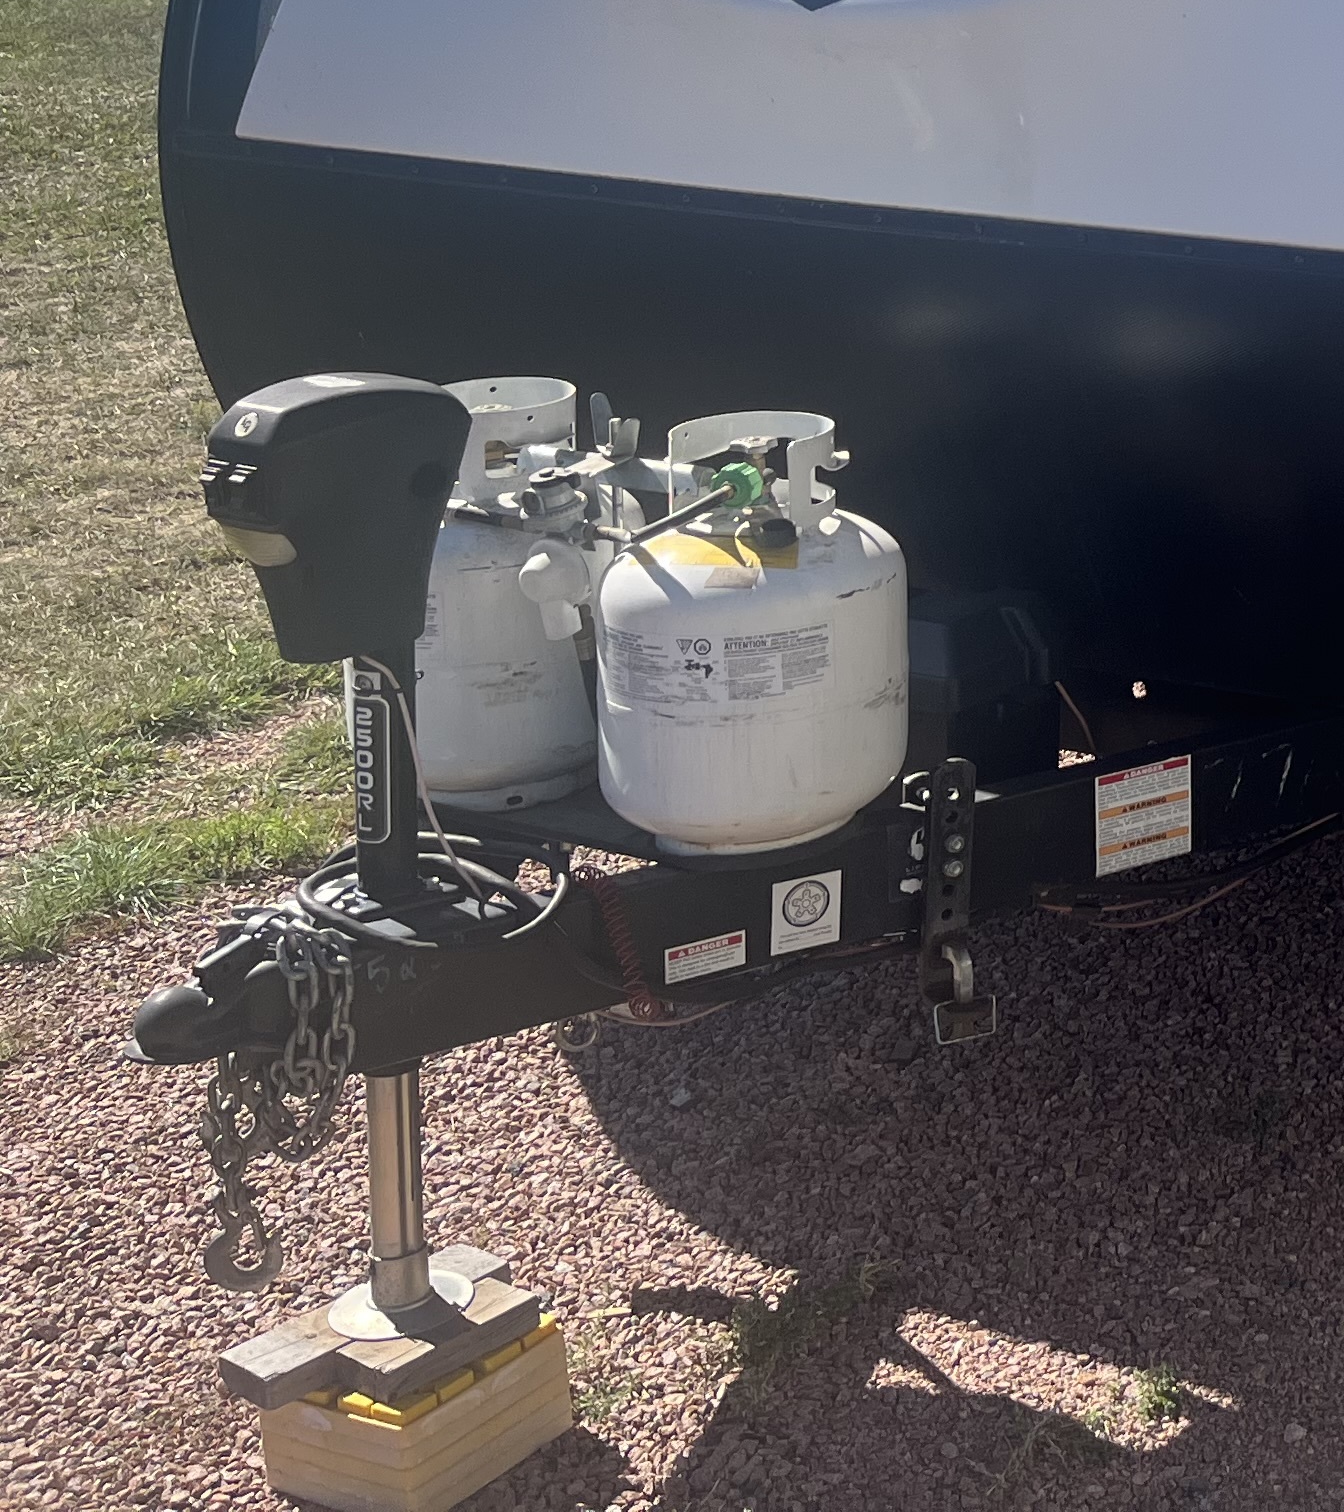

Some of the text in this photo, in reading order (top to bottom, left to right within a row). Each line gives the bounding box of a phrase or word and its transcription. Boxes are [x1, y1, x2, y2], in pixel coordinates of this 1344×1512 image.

[1130, 764, 1164, 778] DANGER
[1129, 796, 1167, 811] WARNING
[1129, 832, 1167, 848] WARNING
[687, 938, 729, 955] DANGER
